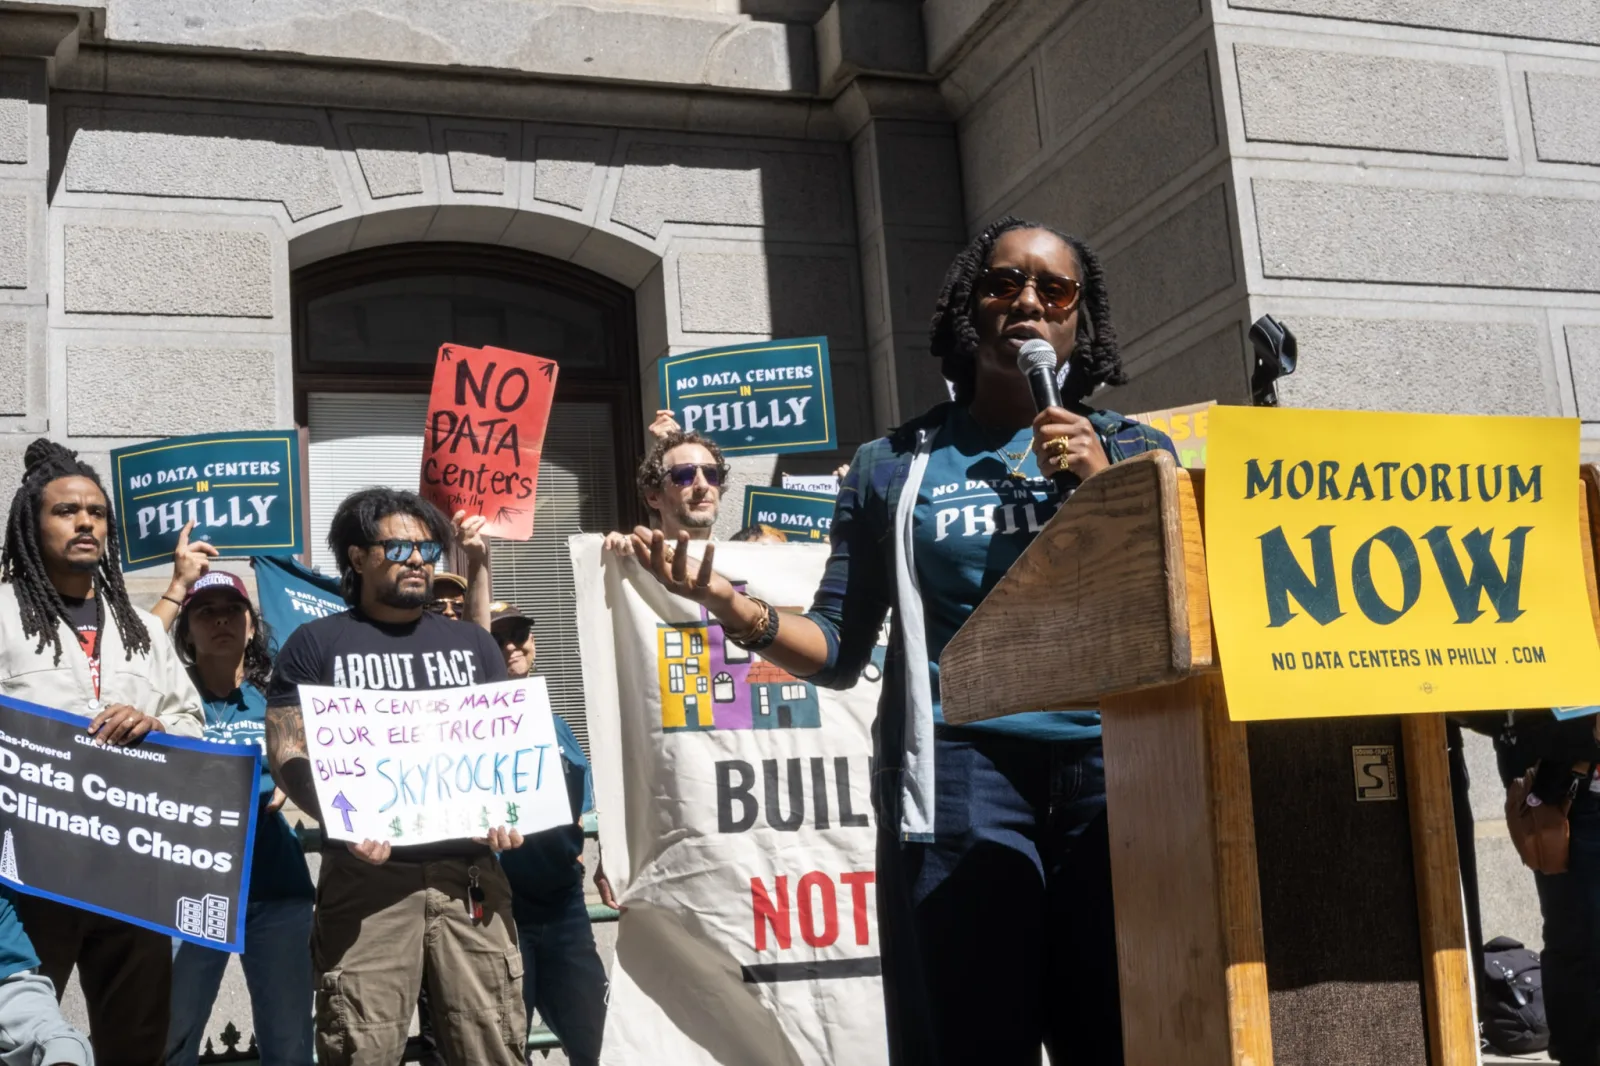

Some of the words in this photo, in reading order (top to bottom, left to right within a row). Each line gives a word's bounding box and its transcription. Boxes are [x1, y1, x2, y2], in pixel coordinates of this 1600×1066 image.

[455, 359, 529, 413] NO
[676, 376, 698, 391] NO
[703, 371, 741, 386] DATA
[746, 365, 813, 383] CENTERS
[740, 385, 752, 396] IN
[682, 396, 812, 434] PHILLY
[432, 410, 520, 467] DATA
[130, 475, 152, 490] NO
[158, 466, 198, 484] DATA
[204, 461, 280, 477] CENTERS
[196, 480, 209, 492] IN
[423, 457, 532, 500] Centers
[932, 482, 959, 498] NO
[965, 480, 1014, 491] DATA
[1013, 489, 1028, 499] IN
[1244, 458, 1543, 503] MORATORIUM
[137, 495, 278, 540] PHILLY
[757, 511, 777, 523] NO
[781, 513, 813, 527] DATA
[810, 529, 820, 539] IN
[934, 503, 1062, 541] PHIL
[1255, 524, 1536, 628] NOW
[296, 591, 317, 602] DATA
[334, 652, 415, 689] ABOUT
[422, 650, 478, 687] FACE
[1271, 652, 1296, 671] NO
[1302, 651, 1344, 669] DATA
[1350, 649, 1421, 668] CENTERS
[1425, 648, 1443, 666] IN
[1447, 647, 1497, 666] PHILLY
[312, 697, 367, 716] DATA
[459, 688, 526, 711] MAKE
[123, 747, 167, 763] COUNCIL
[317, 726, 375, 747] OUR
[0, 748, 75, 792] Data
[82, 773, 213, 827] Centers
[316, 756, 366, 781] BILLS
[376, 743, 552, 813] SKYROCKET
[714, 756, 872, 834] BUIL
[0, 785, 121, 846] Climate
[127, 827, 233, 873] Chaos
[750, 870, 876, 952] NOT
